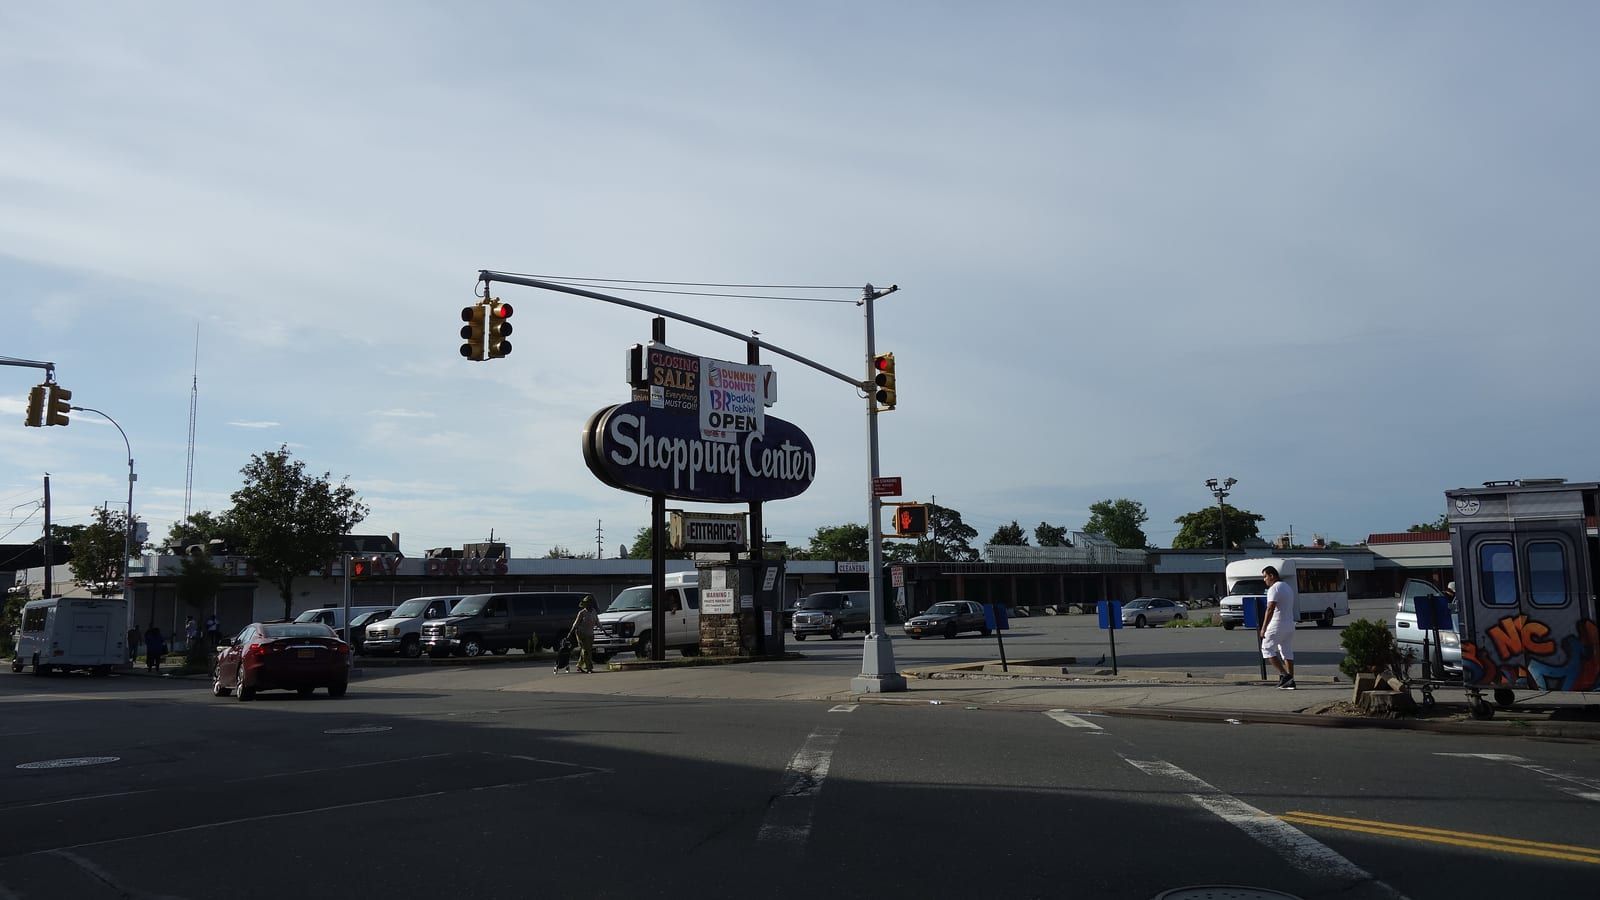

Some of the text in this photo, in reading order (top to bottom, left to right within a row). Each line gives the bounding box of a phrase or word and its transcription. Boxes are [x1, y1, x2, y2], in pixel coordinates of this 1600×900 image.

[650, 352, 699, 372] CLOSING
[654, 367, 696, 391] SALE
[722, 368, 757, 382] DUNKIN'
[723, 380, 756, 393] DONUTS
[664, 399, 681, 408] MUST
[665, 389, 698, 404] Everything
[710, 389, 732, 411] BR
[731, 390, 755, 403] baskin
[732, 403, 756, 415] robbins
[709, 412, 757, 431] OPEN
[611, 413, 815, 493] Shopping Center
[690, 522, 737, 541] ENTRANCE
[426, 556, 509, 576] DRUGS
[838, 564, 866, 572] CLEANERS
